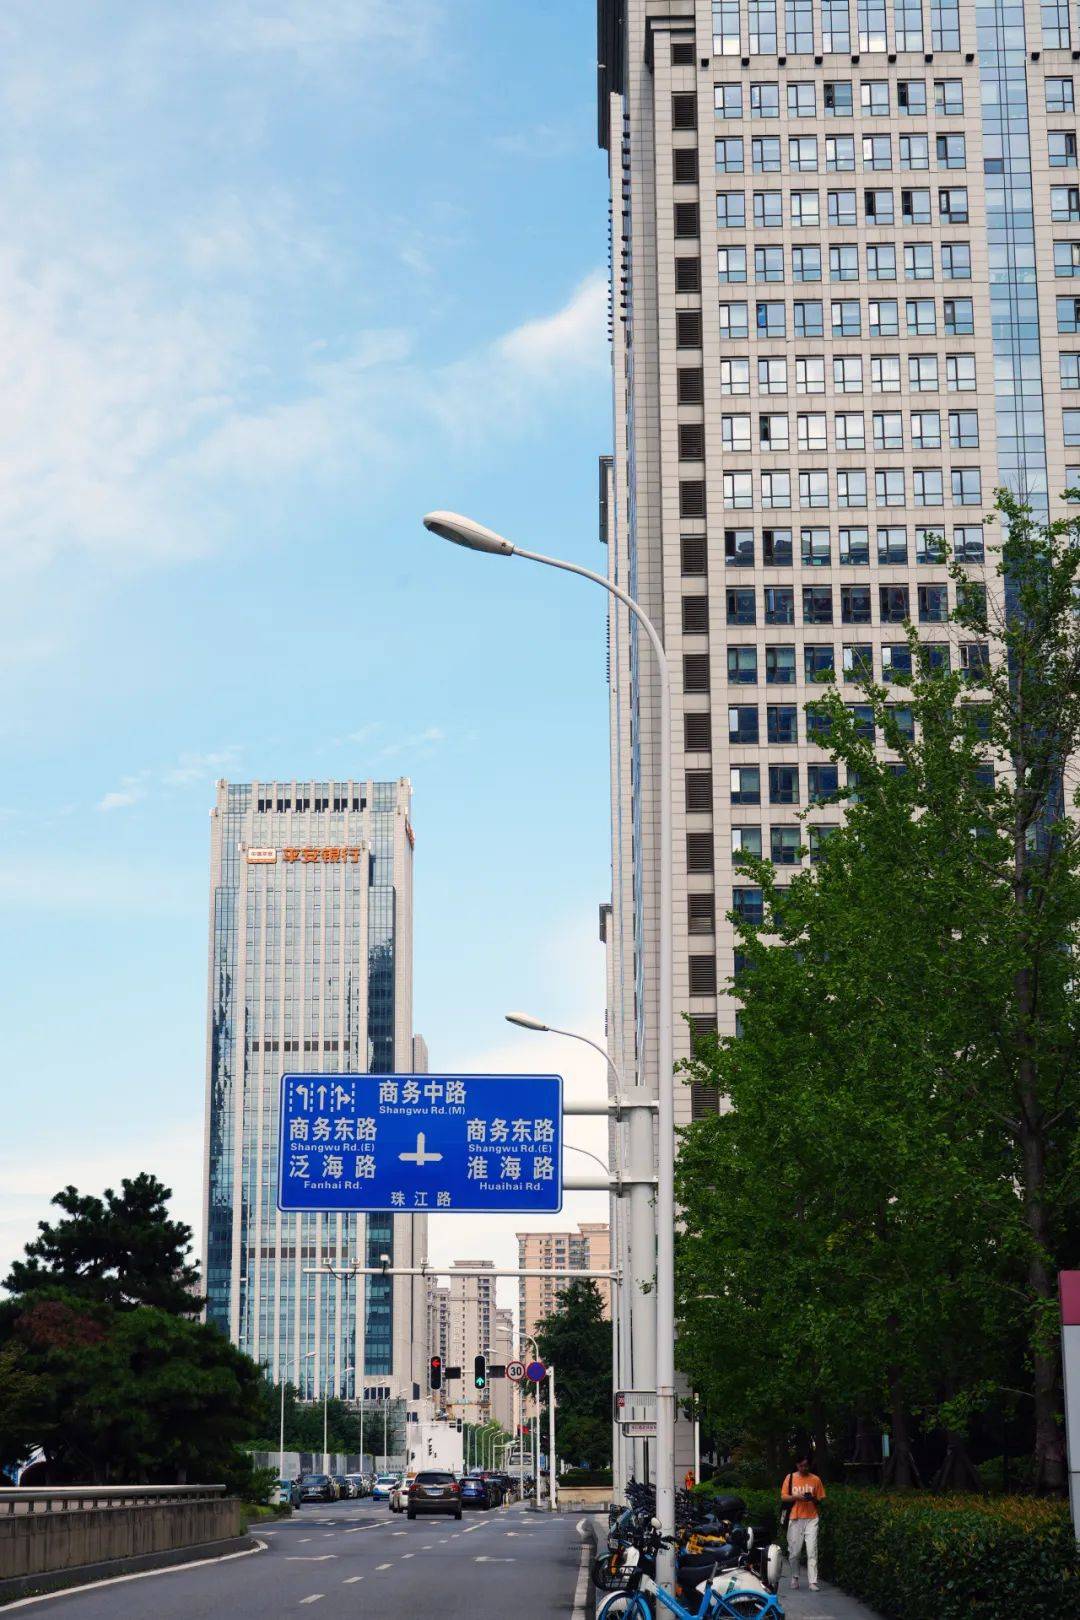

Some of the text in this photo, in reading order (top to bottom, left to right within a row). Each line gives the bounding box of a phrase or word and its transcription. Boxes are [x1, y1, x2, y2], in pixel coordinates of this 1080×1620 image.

[379, 1080, 467, 1104] 商务中路
[379, 1105, 466, 1116] Shangwu Rd.(M)
[289, 1117, 377, 1141] 商务东路
[467, 1118, 555, 1142] 商务东路
[290, 1142, 375, 1152] Shangwu Rd.(E)
[469, 1144, 552, 1154] Shangwu Rd.(E)
[289, 1154, 376, 1179] 泛海路
[467, 1156, 554, 1180] 淮海路
[304, 1181, 363, 1189] Fanhai Rd.
[480, 1182, 544, 1191] Huaihai Rd.
[391, 1190, 451, 1207] 珠江路
[510, 1366, 522, 1376] 30
